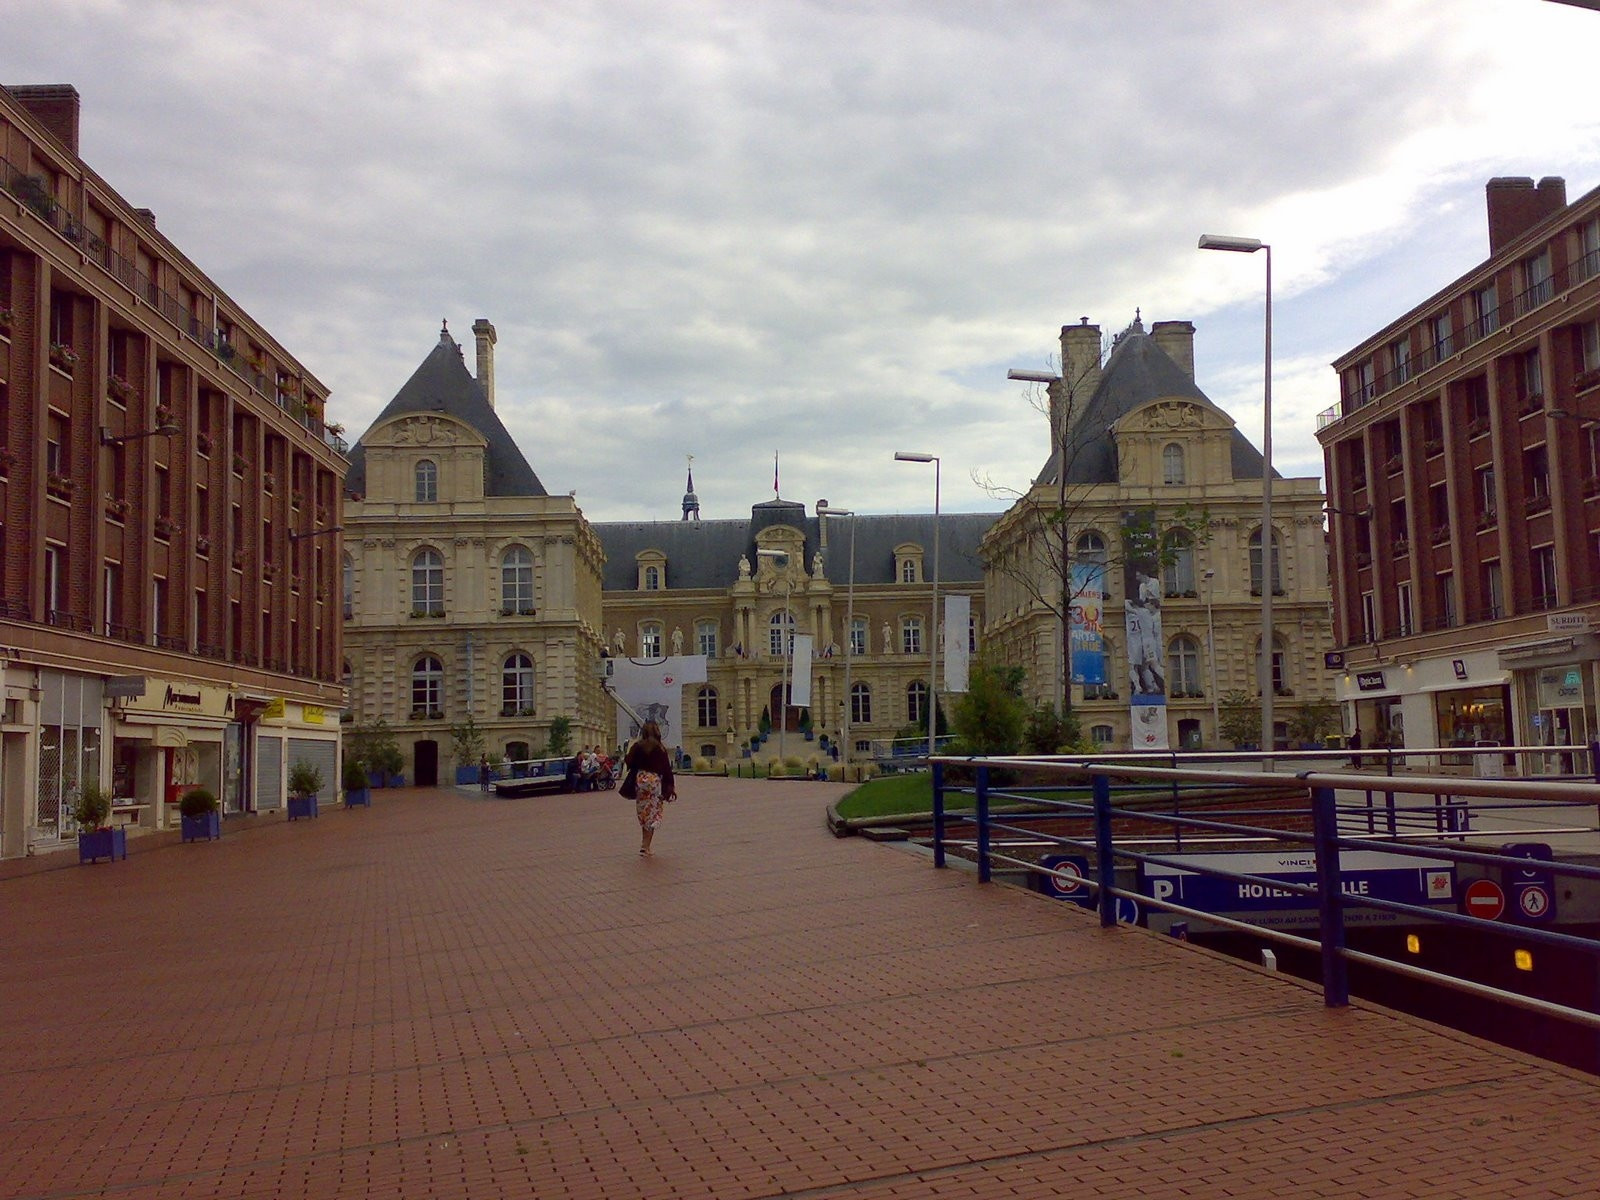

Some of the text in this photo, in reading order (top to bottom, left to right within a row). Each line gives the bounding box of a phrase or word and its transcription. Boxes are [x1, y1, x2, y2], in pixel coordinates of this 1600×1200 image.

[1457, 809, 1465, 831] P
[1278, 859, 1311, 867] VINCI
[1153, 879, 1174, 901] P
